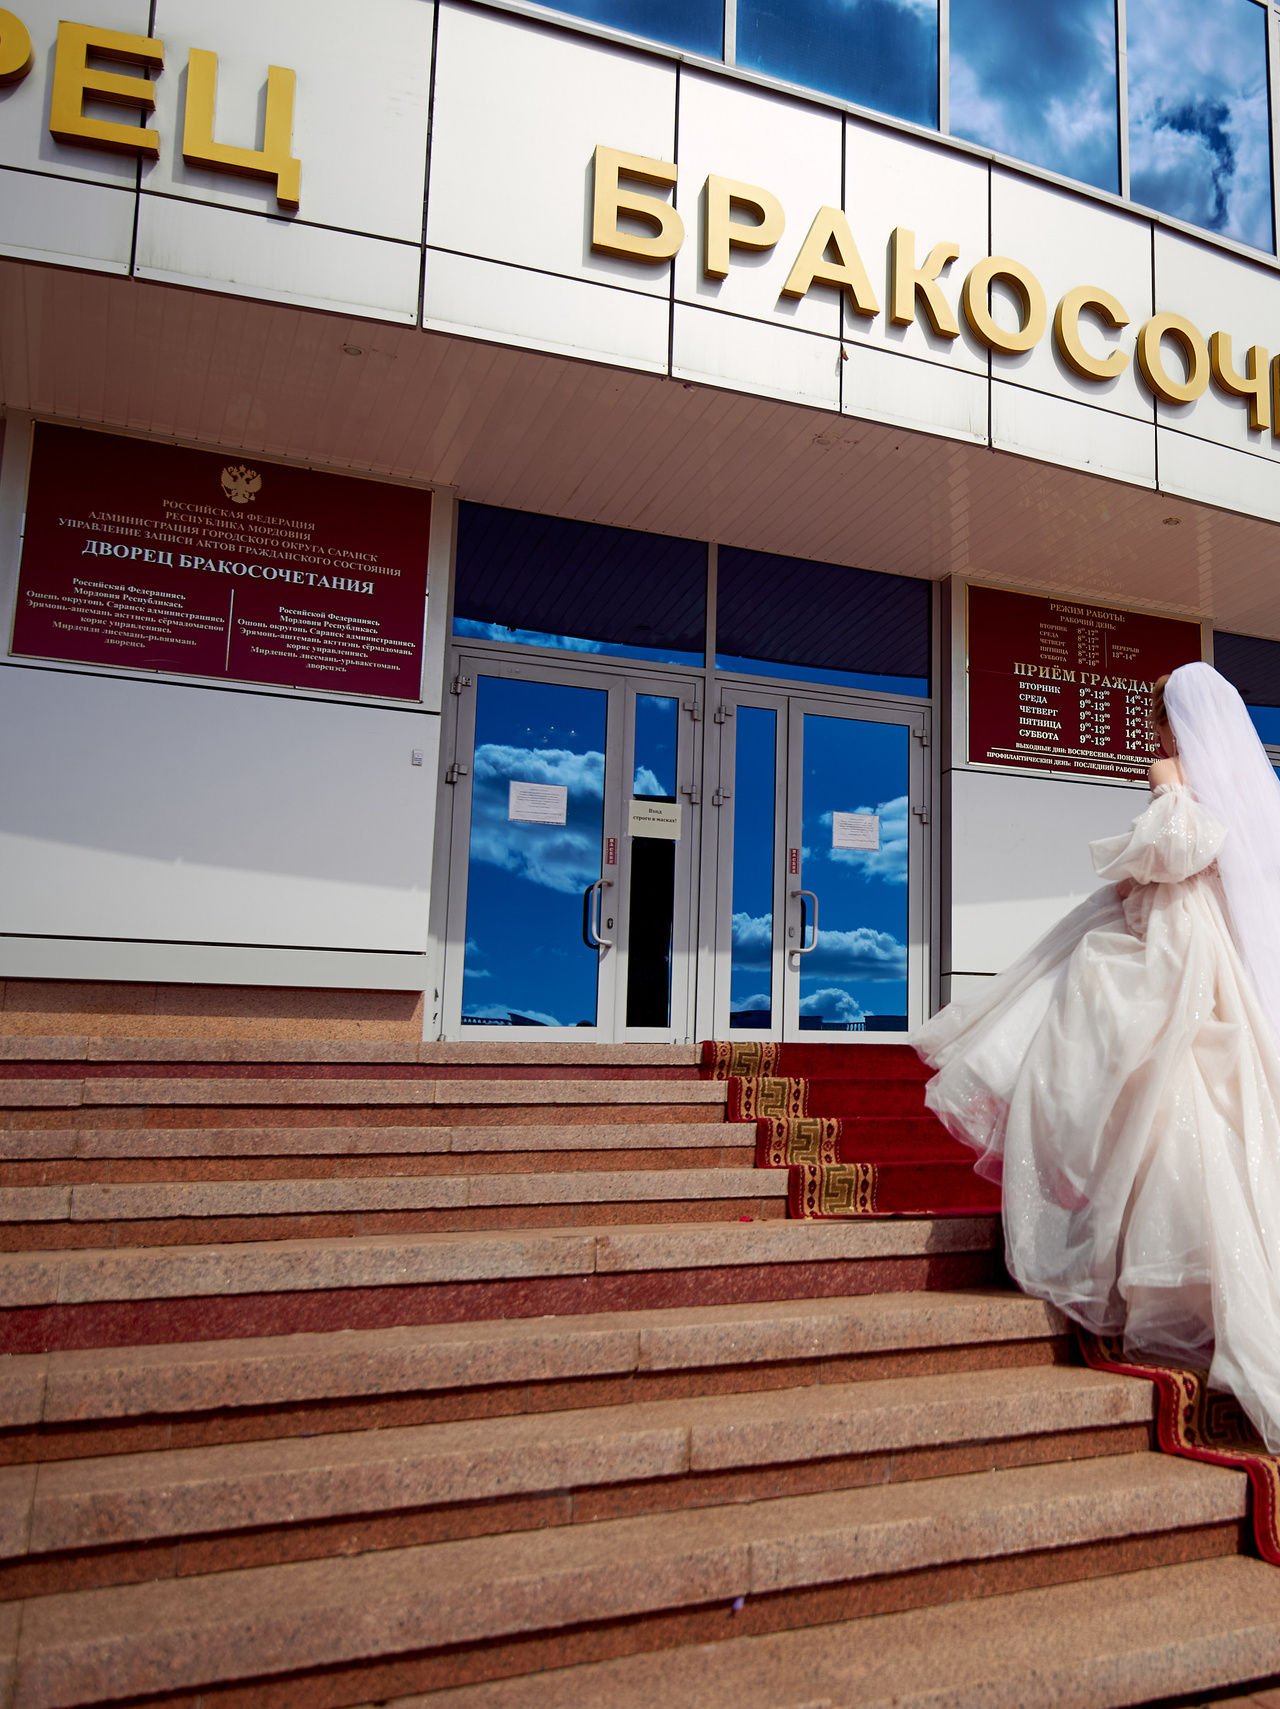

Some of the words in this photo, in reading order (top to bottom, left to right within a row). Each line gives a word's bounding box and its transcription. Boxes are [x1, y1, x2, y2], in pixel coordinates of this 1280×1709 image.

[163, 500, 244, 519] РОССИЙСКАЯ
[247, 513, 315, 531] ФЕДЕРАЦИЯ
[165, 511, 245, 531] РЕСПУБЛИКА
[248, 524, 311, 541] МОРДОВИЯ
[88, 511, 199, 535] АДМИНИСТРАЦИЯ
[202, 528, 279, 547] ГОРОДСКОГО
[281, 541, 325, 554] ОКРУГА
[327, 547, 379, 562] САРАНСК
[58, 517, 141, 537] УПРАВЛЕНИЕ
[144, 531, 193, 546] ЗАПИСИ
[196, 539, 236, 552] АКТОВ
[238, 545, 331, 566] ГРАЖДАНСКОГО
[333, 559, 401, 577] СОСТОЯНИЯ
[81, 539, 174, 568] ДВОРЕЦ
[178, 553, 375, 595] БРАКОСОЧЕТАНИЯ
[73, 586, 120, 601] Мордовия
[106, 600, 145, 613] Саранск
[1050, 603, 1084, 616] РЕЖИМ
[1086, 610, 1126, 622] РАБОТЫ:
[280, 615, 322, 627] Мордовия
[1039, 622, 1068, 632] ВТОРНИК
[1060, 615, 1094, 627] РАБОЧИЙ
[309, 627, 345, 639] Саранск
[1039, 631, 1059, 639] СРЕДА
[1039, 638, 1066, 647] ЧЕТВЕРГ
[1040, 645, 1069, 655] ПЯТНИЦА
[1040, 653, 1067, 662] СУББОТА
[1013, 662, 1076, 683] ПРИЁМ
[1019, 681, 1061, 694] ВТОРНИК
[1019, 693, 1048, 704] СРЕДА
[1019, 705, 1059, 717] ЧЕТВЕРГ
[1019, 716, 1062, 730] ПЯТНИЦА
[1019, 728, 1060, 741] СУББОТА
[1015, 742, 1052, 752] ВЫХОДНЫЕ
[1067, 748, 1116, 760] ВОСКРЕСЕНЬЕ,
[1117, 753, 1161, 764] ПОНЕДЕЛЬНИ
[986, 751, 1053, 764] ПРОФИЛАКТИЧЕСКИЙ
[1074, 761, 1115, 771] ПОСЛЕДНИЙ
